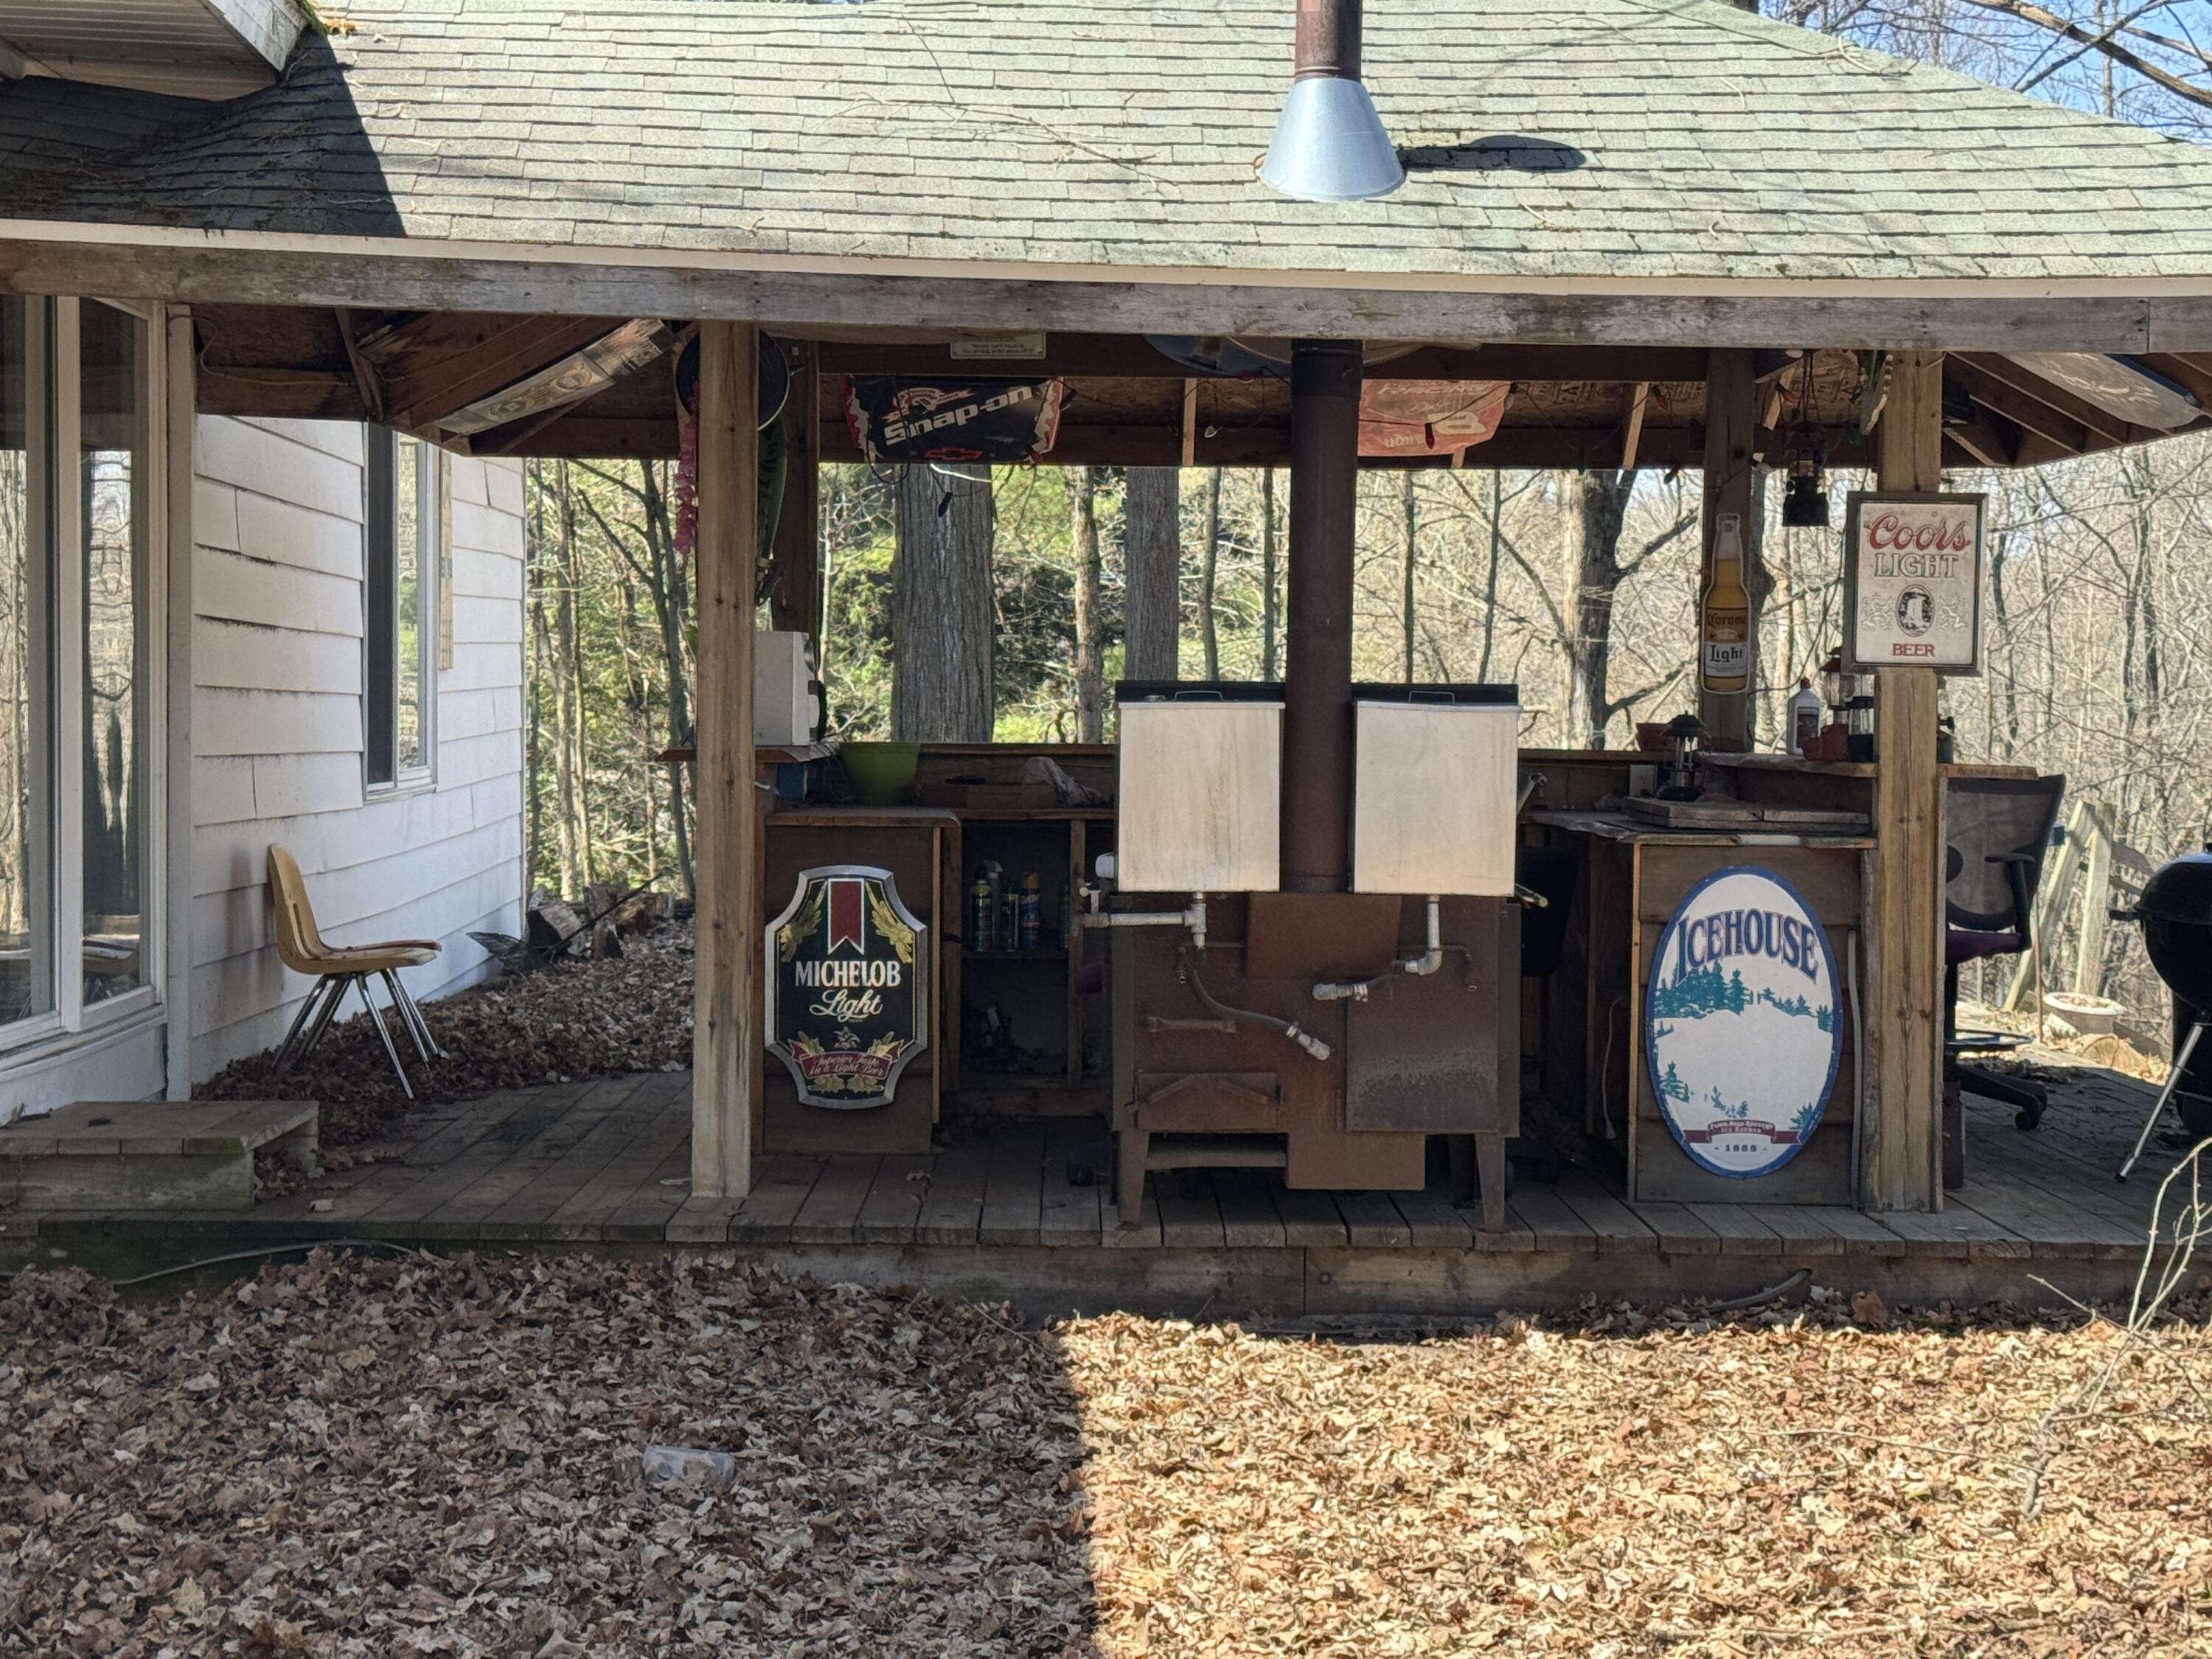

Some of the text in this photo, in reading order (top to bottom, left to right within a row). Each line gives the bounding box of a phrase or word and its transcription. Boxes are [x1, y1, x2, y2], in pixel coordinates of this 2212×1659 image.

[883, 386, 1032, 446] Snap-on
[1864, 513, 1972, 551] Coors
[1874, 552, 1959, 578] LIGHT
[1706, 612, 1747, 628] Corona
[1709, 644, 1744, 664] Light
[1891, 642, 1935, 657] BEER
[1676, 908, 1818, 984] ICEHOUSE
[794, 960, 902, 988] MICHELOB
[809, 990, 883, 1023] Light
[1724, 1144, 1758, 1152] 1855
